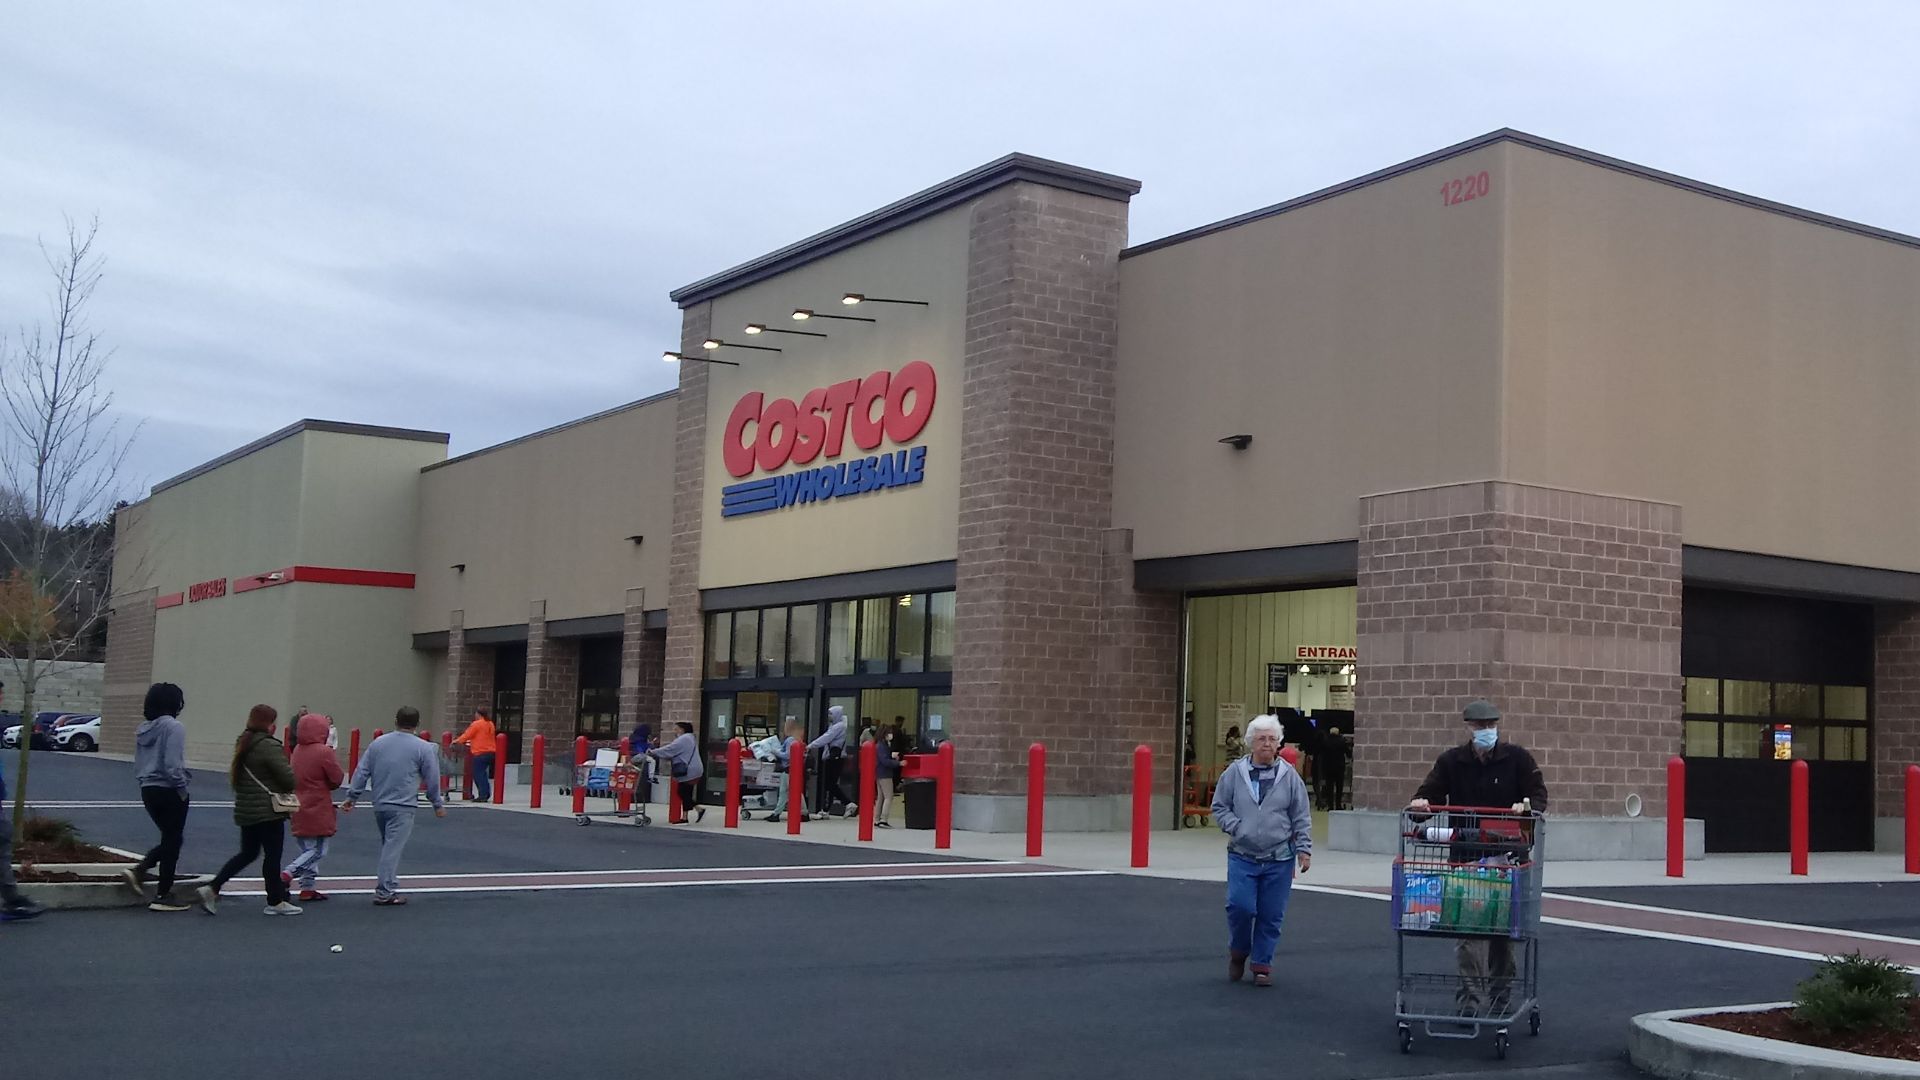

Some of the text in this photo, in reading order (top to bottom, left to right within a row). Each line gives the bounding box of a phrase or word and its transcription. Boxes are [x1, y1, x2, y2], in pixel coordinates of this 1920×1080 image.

[1440, 170, 1489, 207] 1220
[723, 360, 937, 478] COSTCO
[774, 446, 927, 508] WHOLESALE
